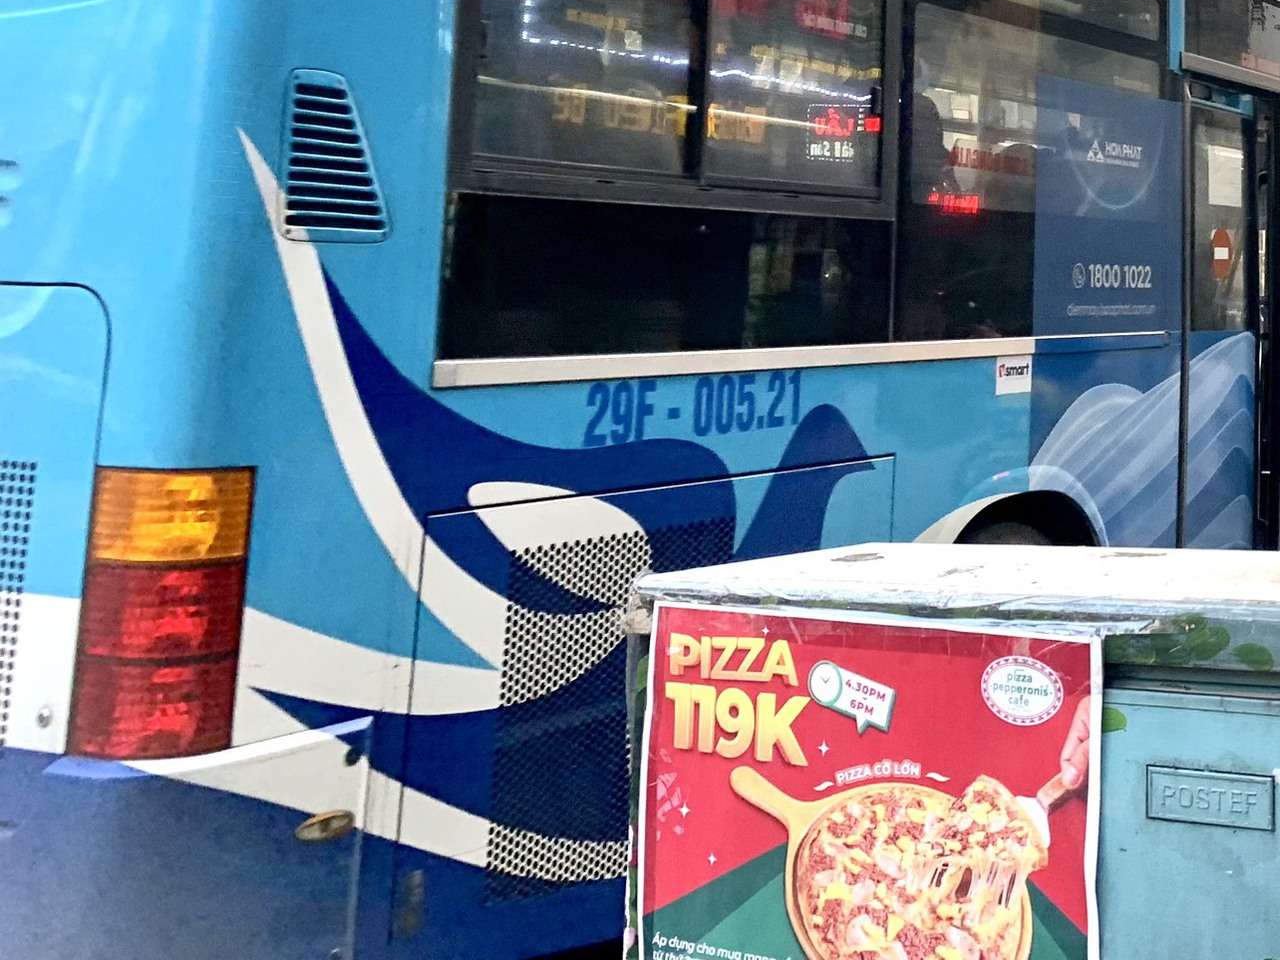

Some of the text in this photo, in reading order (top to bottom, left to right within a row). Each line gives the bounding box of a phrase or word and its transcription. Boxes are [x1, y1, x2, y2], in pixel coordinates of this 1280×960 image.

[1088, 264, 1152, 288] 1800 1022
[582, 379, 657, 447] 29F
[693, 370, 803, 437] 005.21
[669, 632, 799, 687] PIZZA
[845, 679, 886, 702] 4.30PM
[850, 699, 874, 716] 6PM
[665, 682, 811, 766] 119K
[836, 759, 920, 784] PIZZA CỠ LỚN
[1161, 785, 1257, 814] POSTEF
[652, 932, 667, 947] Áp
[668, 936, 695, 953] dụng
[696, 943, 715, 956] cho
[717, 948, 741, 960] mua
